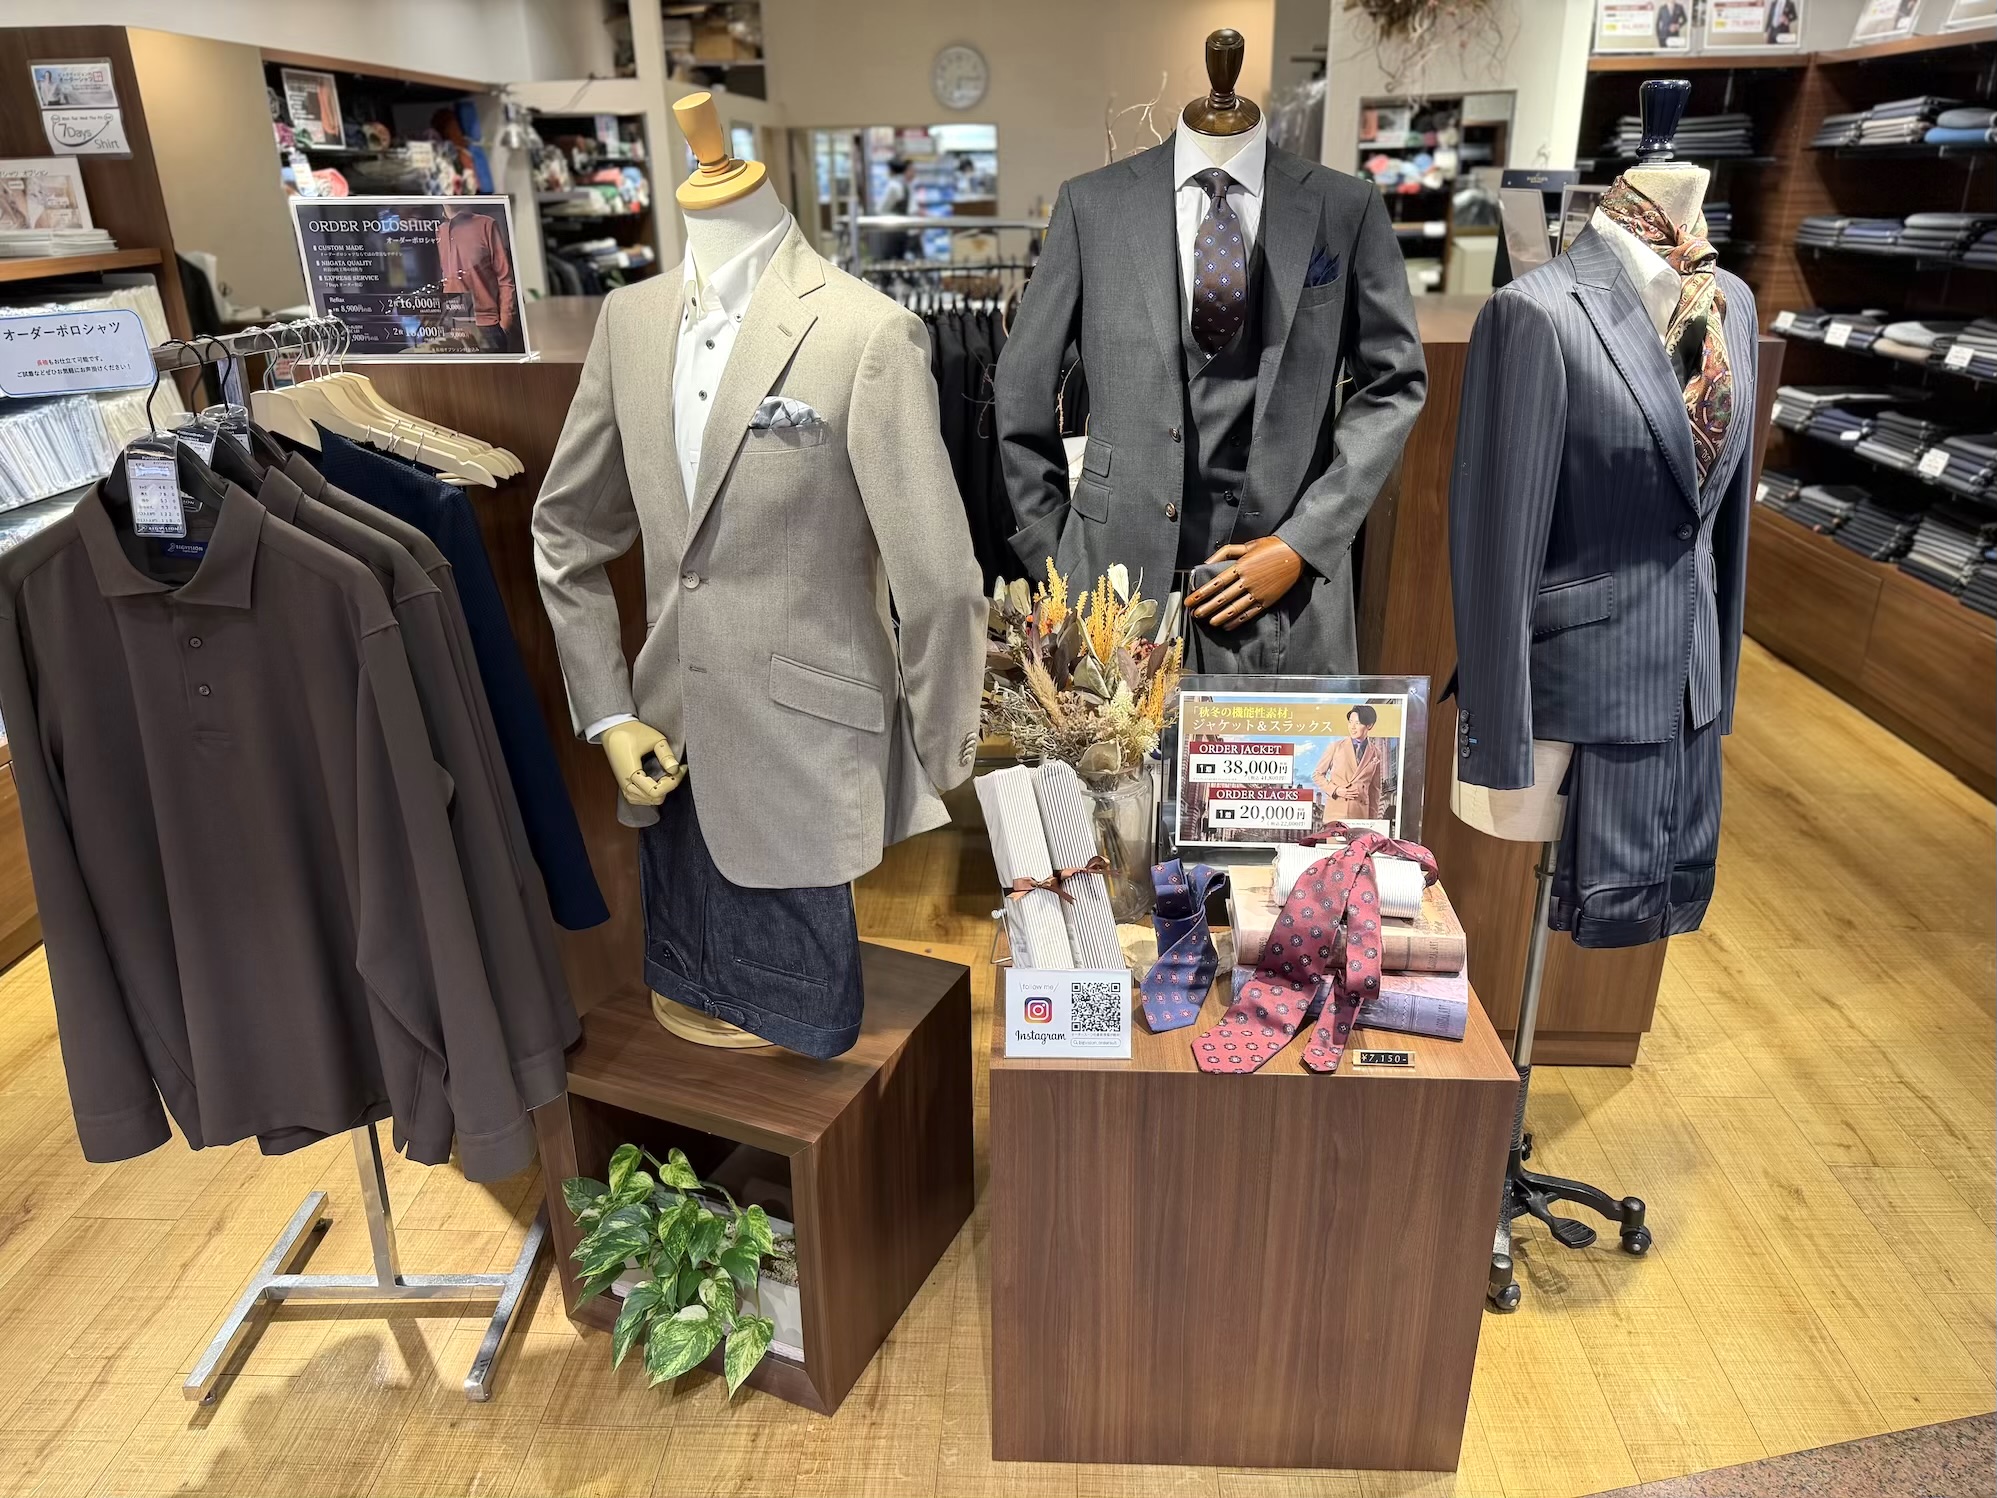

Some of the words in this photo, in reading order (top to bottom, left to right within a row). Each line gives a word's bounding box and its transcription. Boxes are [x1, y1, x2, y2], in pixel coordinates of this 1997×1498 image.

[95, 139, 119, 149] Shirt
[309, 220, 359, 232] ORDER
[363, 220, 440, 232] POLOSHIRT
[3, 321, 120, 341] オーダーポロシャツ
[1193, 706, 1294, 720] 「秋冬の機能性素材」
[1193, 719, 1333, 733] ジャケット&スラックス
[1199, 744, 1238, 754] ORDER
[1240, 744, 1281, 755] JACKET
[1216, 790, 1255, 800] ORDER
[1257, 791, 1299, 800] SLACKS
[1015, 1030, 1066, 1045] Instagram
[1361, 1053, 1407, 1063] ¥7,150-
